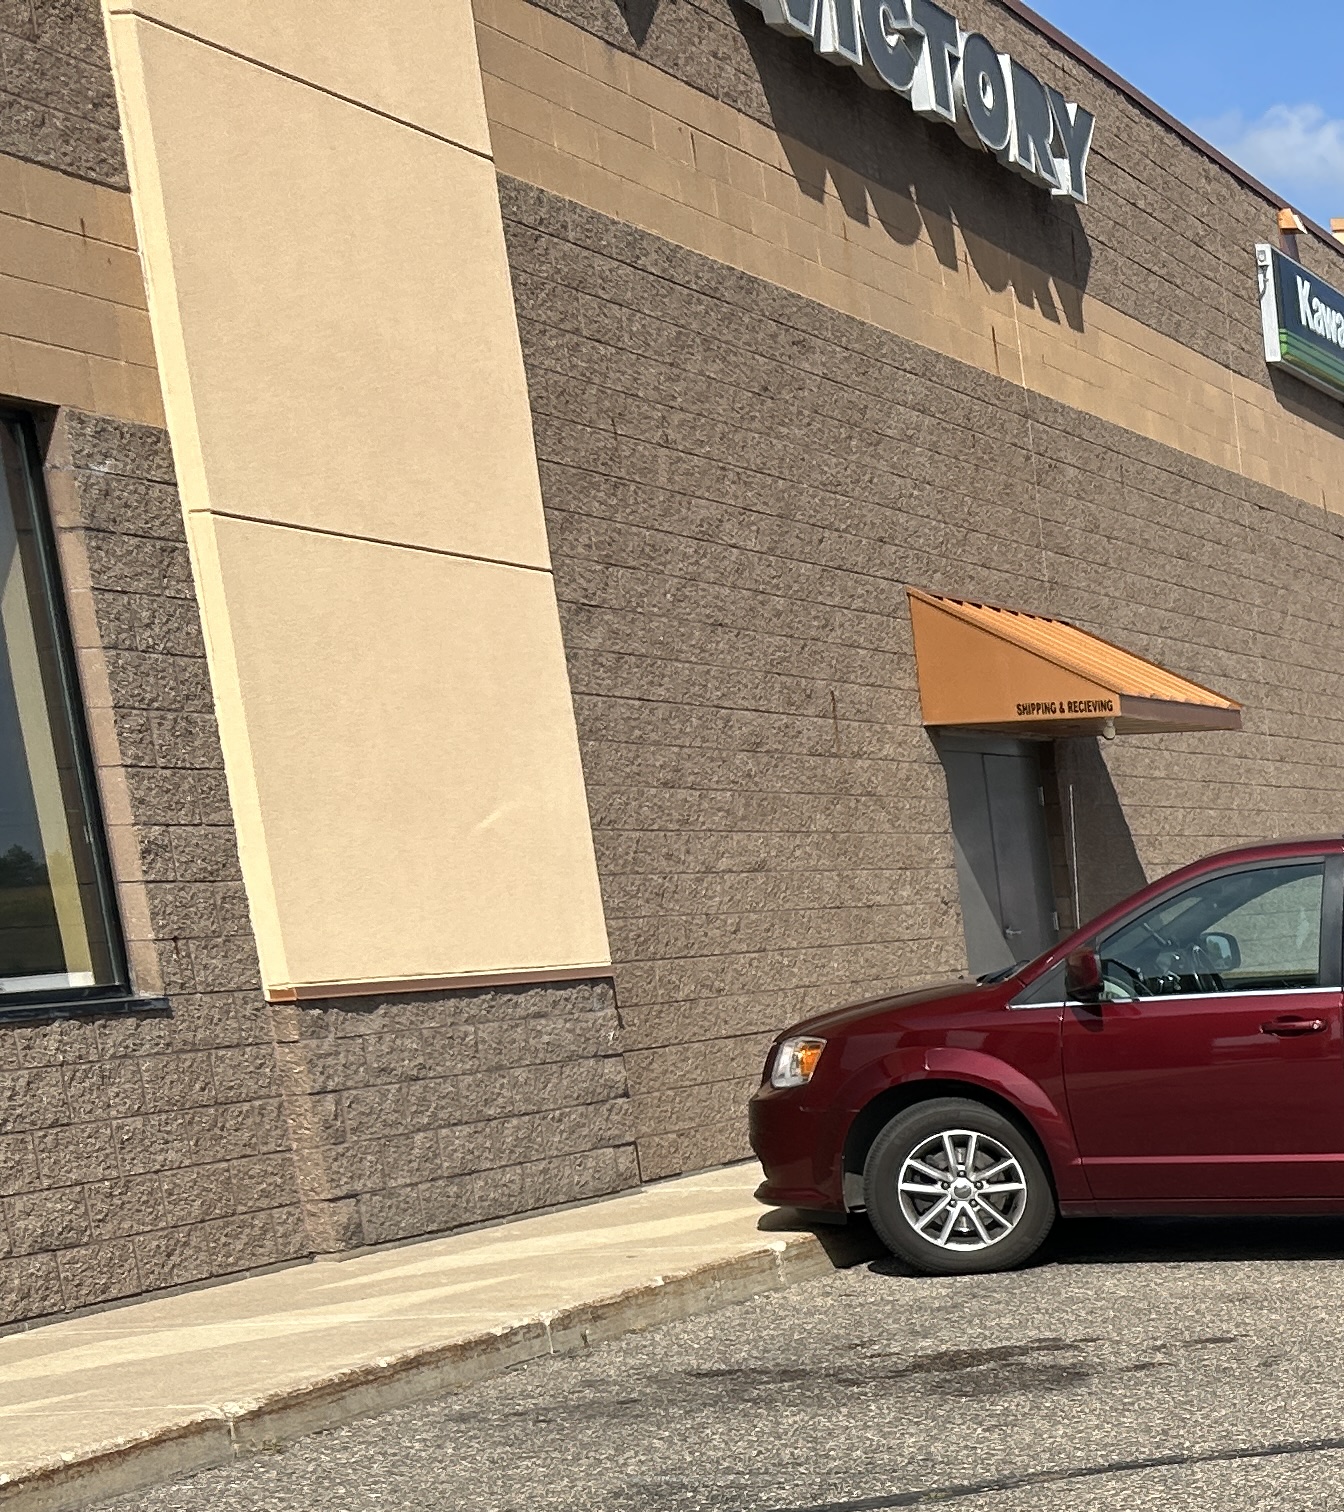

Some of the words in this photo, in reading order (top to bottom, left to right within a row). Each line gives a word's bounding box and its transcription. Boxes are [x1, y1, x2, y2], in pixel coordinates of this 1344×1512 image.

[764, 0, 1096, 204] ICTORY
[1016, 702, 1057, 716] SHIPPING
[1059, 701, 1066, 714] &
[1067, 699, 1114, 713] RECIEVING
